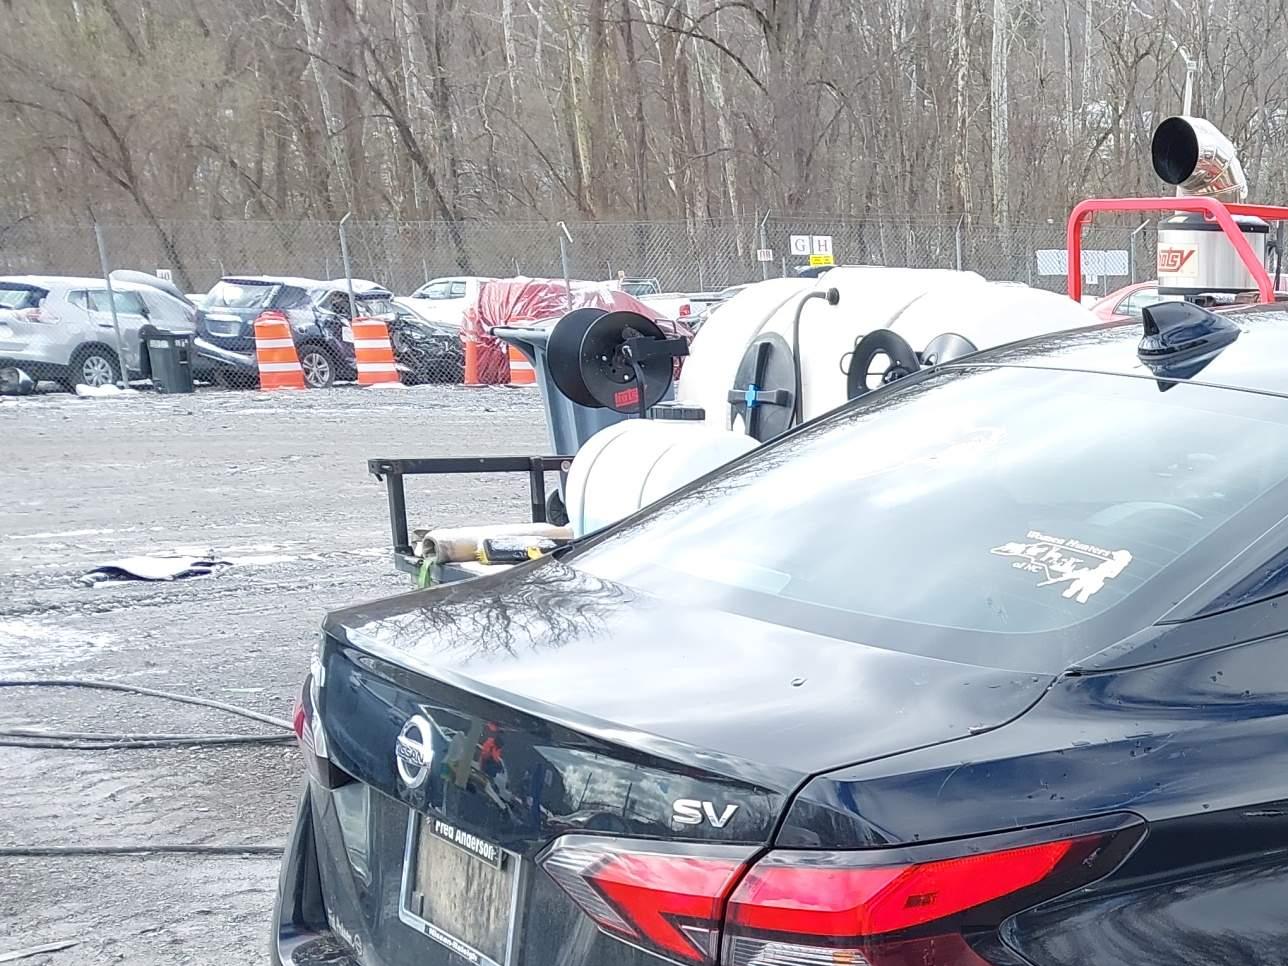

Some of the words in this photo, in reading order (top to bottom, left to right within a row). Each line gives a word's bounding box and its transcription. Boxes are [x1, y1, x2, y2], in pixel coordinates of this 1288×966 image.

[794, 238, 806, 252] G
[817, 239, 829, 252] H
[672, 798, 739, 828] SV
